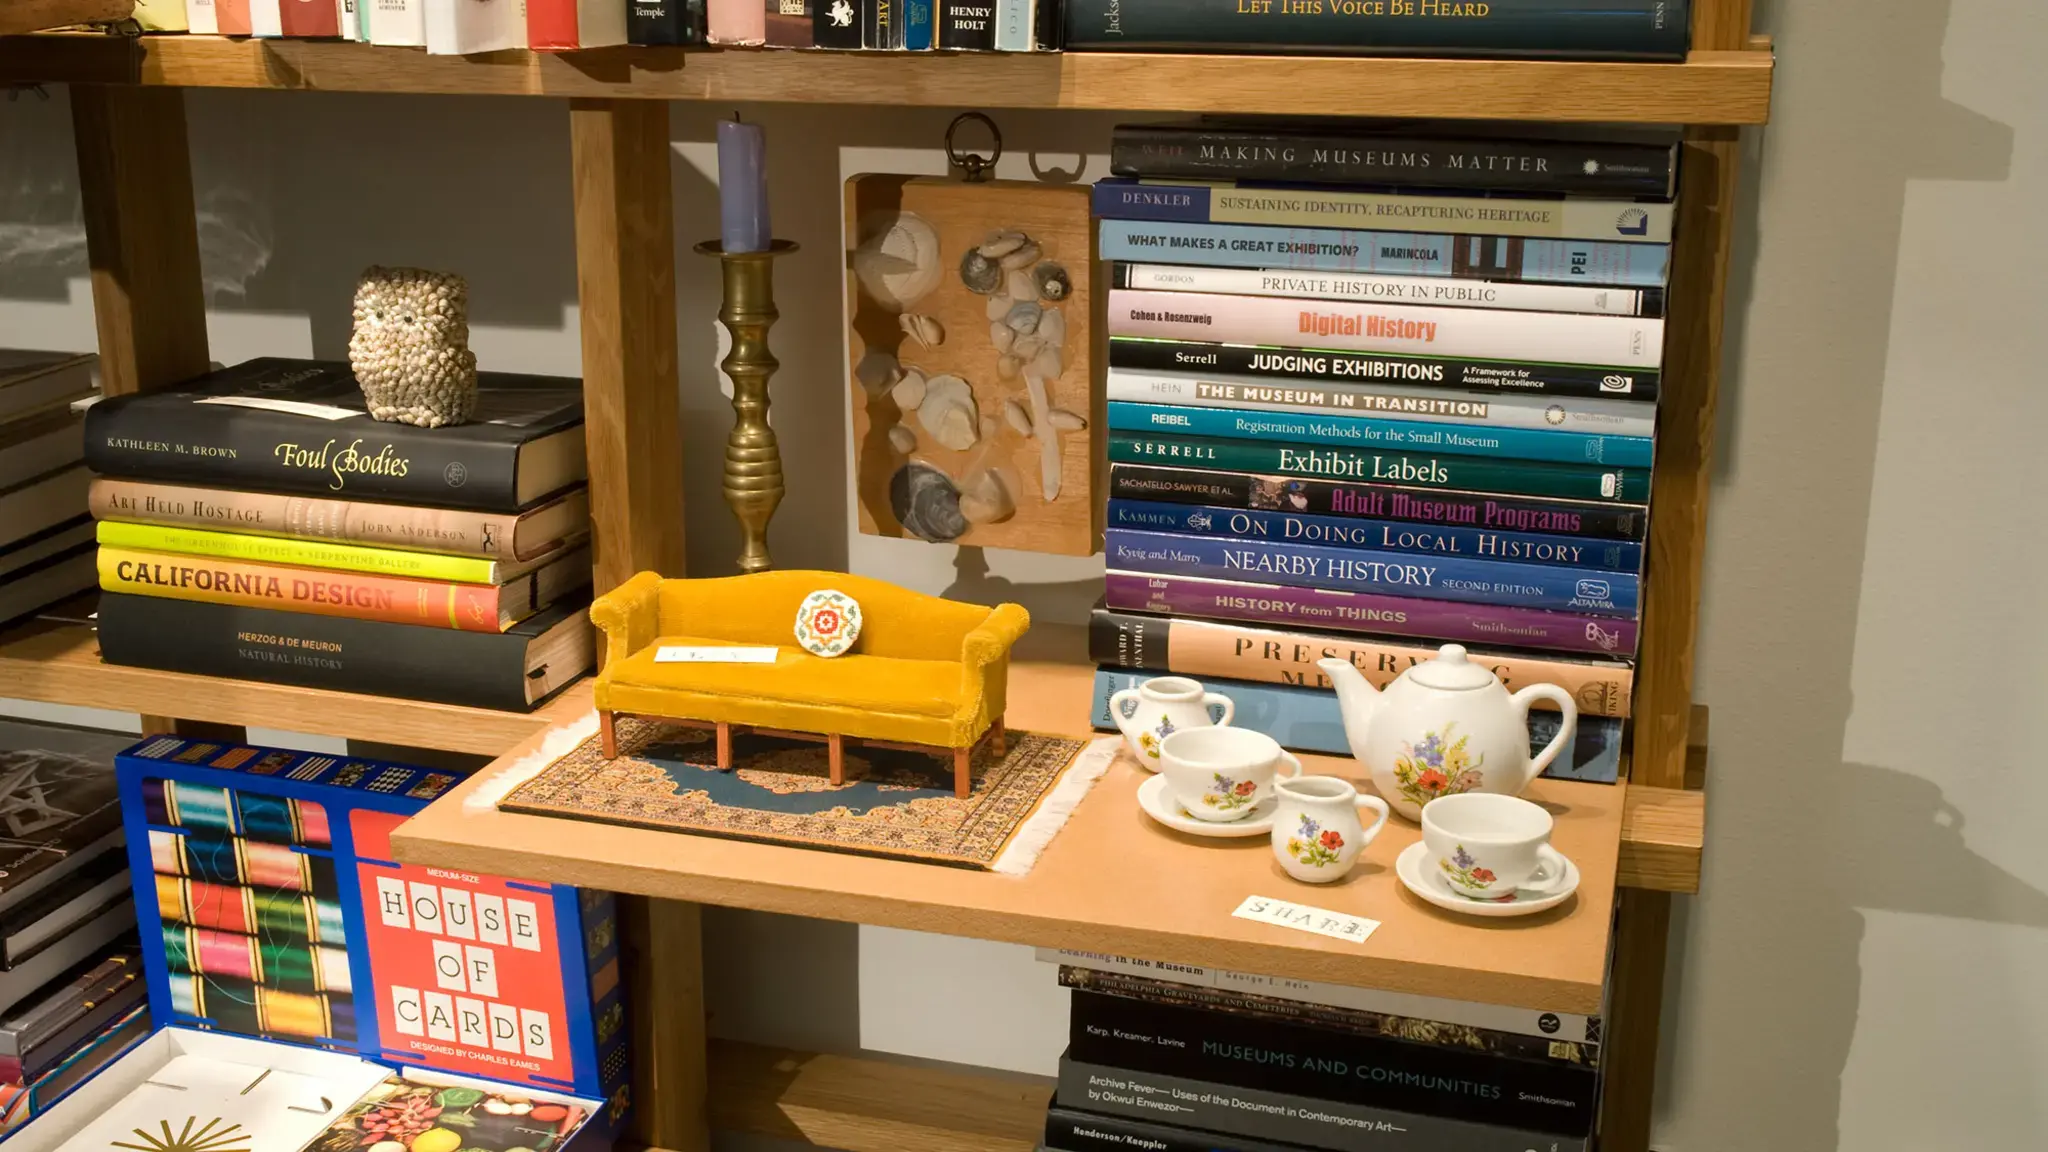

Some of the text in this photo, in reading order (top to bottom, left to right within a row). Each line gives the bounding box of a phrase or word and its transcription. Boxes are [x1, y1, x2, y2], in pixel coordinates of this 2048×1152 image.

[636, 7, 665, 19] Temple
[949, 6, 992, 18] HENRY
[1237, 0, 1273, 14] LET
[1329, 0, 1384, 15] VOICE
[1390, 0, 1414, 16] BE
[1420, 0, 1489, 16] HEARD
[1655, 2, 1665, 29] PENN
[954, 19, 986, 31] HOLT
[1200, 144, 1296, 163] MAKING
[1312, 149, 1431, 168] MUSEUMS
[1448, 154, 1549, 173] MATTER
[1122, 191, 1551, 223] DENKLER SUSTAINING IDENTITY, RECAPTURING HERITAGE
[1127, 234, 1439, 261] WHAT MAKES A GREAT EXHIBITION? MARINCOLA
[1571, 251, 1587, 275] PEI
[1154, 274, 1496, 302] GORDON PRIVATE HISTORY IN PUBLIC
[1130, 309, 1437, 342] Cohen & Rosenzweig Digital History
[1632, 329, 1643, 356] PENN
[1175, 352, 1444, 381] Serrell JUDGING EXHIBITIONS
[1462, 366, 1531, 379] A Framework for
[1462, 375, 1545, 389] Assessing Excellence
[1151, 382, 1182, 395] HEIN
[1199, 384, 1235, 399] THE
[1243, 387, 1324, 404] MUSEUM
[1333, 393, 1354, 407] IN
[1363, 396, 1487, 417] TRANSITION
[1151, 413, 1500, 448] REIBEL Registration Methods for the Small Museum
[107, 437, 410, 490] KATHLEEN M. BROWN Foul Bodies
[1133, 442, 1448, 484] SERRELL Exhibit Labels
[108, 492, 466, 541] ART HELD HOSTAGE JOHN ANDERSON
[1210, 485, 1220, 495] ET
[1331, 488, 1386, 516] Adult
[1391, 492, 1477, 523] Museum
[1484, 501, 1582, 532] Programs
[1118, 508, 1584, 563] KAMMEN ON DOING LOCAL HISTORY
[378, 556, 423, 570] GALLERY
[1117, 545, 1545, 597] Kyvig and Marty NEARBY HISTORY SECOND EDITION
[116, 560, 395, 610] CALIFORNIA DESIGN
[1148, 578, 1169, 589] Lubar
[1215, 595, 1548, 638] HISTORY from THINGS Smithsonian
[237, 631, 342, 653] HERZOG & DE MEURON
[238, 648, 344, 670] NATURAL HISTORY
[1234, 637, 1512, 686] PRESERG
[426, 866, 481, 885] MEDIUM-SIZE
[381, 889, 534, 939] HOUSE
[1248, 900, 1370, 938] SHARE
[437, 954, 489, 983] OF
[1131, 957, 1151, 968] the
[1155, 962, 1205, 976] Museum
[1099, 978, 1162, 995] PHILADELPHIA
[1244, 999, 1300, 1015] CEMETERIES
[397, 998, 545, 1047] CARDS
[410, 1040, 541, 1072] DESIGNED BY CHARLES EAMES
[1157, 1036, 1186, 1049] Lavine
[1202, 1040, 1295, 1068] MUSEUMS
[1303, 1057, 1348, 1076] AND
[1356, 1065, 1502, 1100] COMMUNITIES
[1518, 1091, 1577, 1108] Smithsonian
[1088, 1089, 1101, 1103] by
[1102, 1091, 1136, 1106] Okwui
[1088, 1074, 1127, 1090] Archive
[1172, 1088, 1199, 1103] Uses
[1200, 1092, 1212, 1104] of
[1213, 1094, 1230, 1107] the
[1231, 1097, 1286, 1116] Document
[1286, 1105, 1297, 1117] in
[1298, 1108, 1374, 1132] Contemporary
[1073, 1126, 1168, 1152] Henderson/Kaeppler
